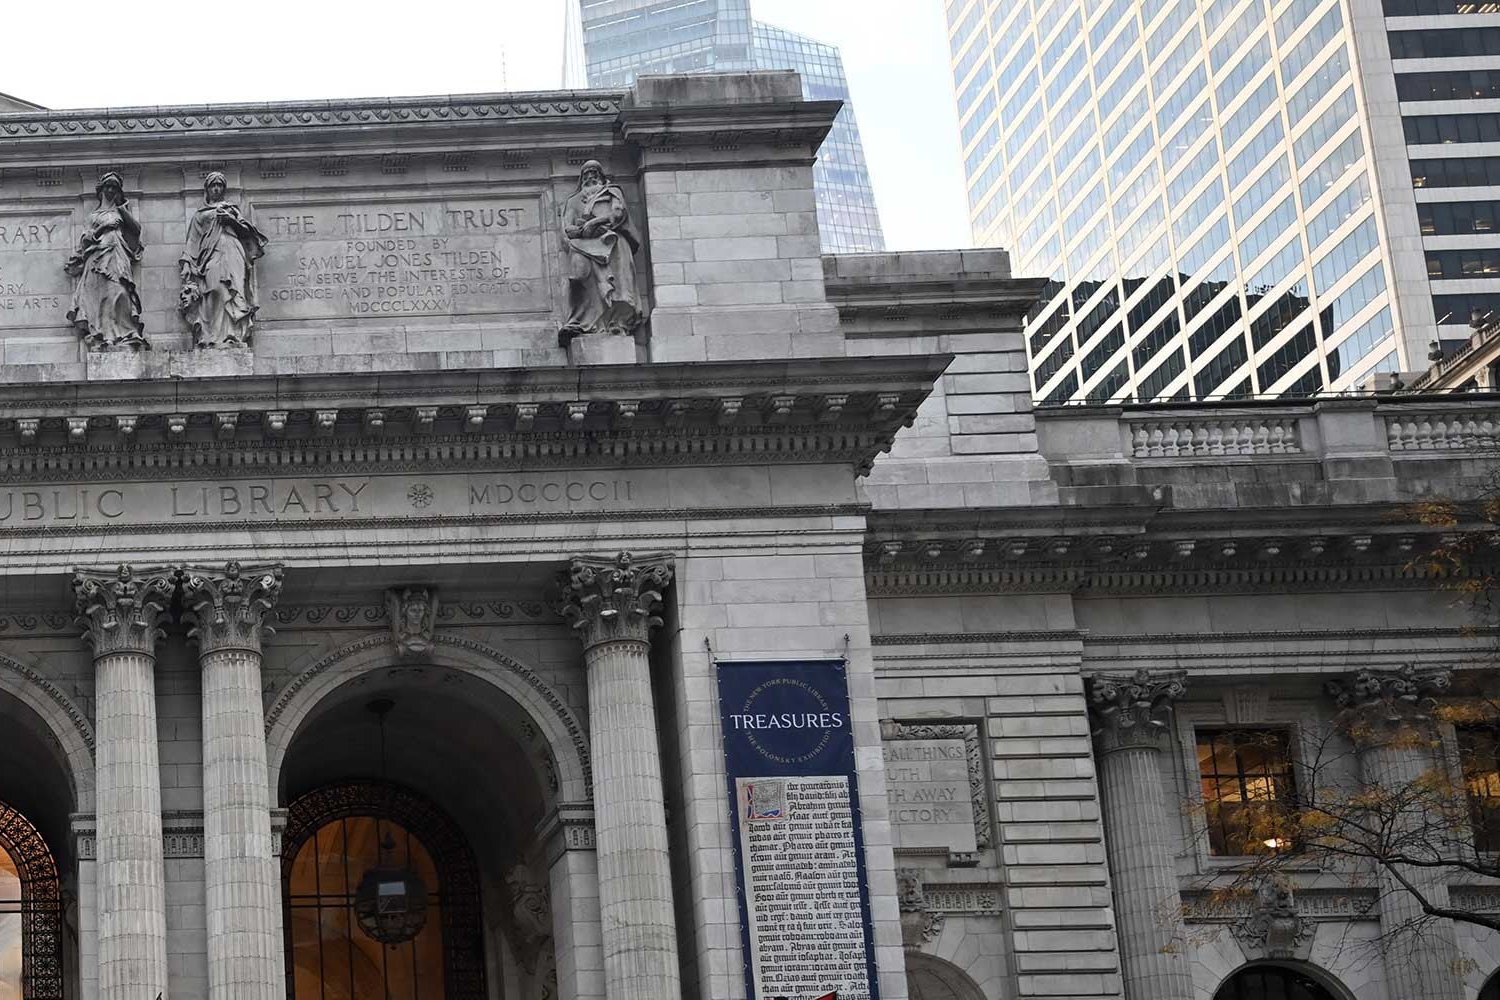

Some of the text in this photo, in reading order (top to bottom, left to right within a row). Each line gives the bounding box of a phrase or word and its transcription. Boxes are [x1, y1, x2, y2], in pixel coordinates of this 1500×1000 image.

[270, 208, 524, 236] THE TILDEN TRUST
[171, 482, 371, 518] LIBRARY
[471, 481, 632, 504] MDCCCCII
[730, 713, 843, 729] TREASURES
[914, 746, 963, 760] THINGS
[913, 788, 957, 801] AWAY
